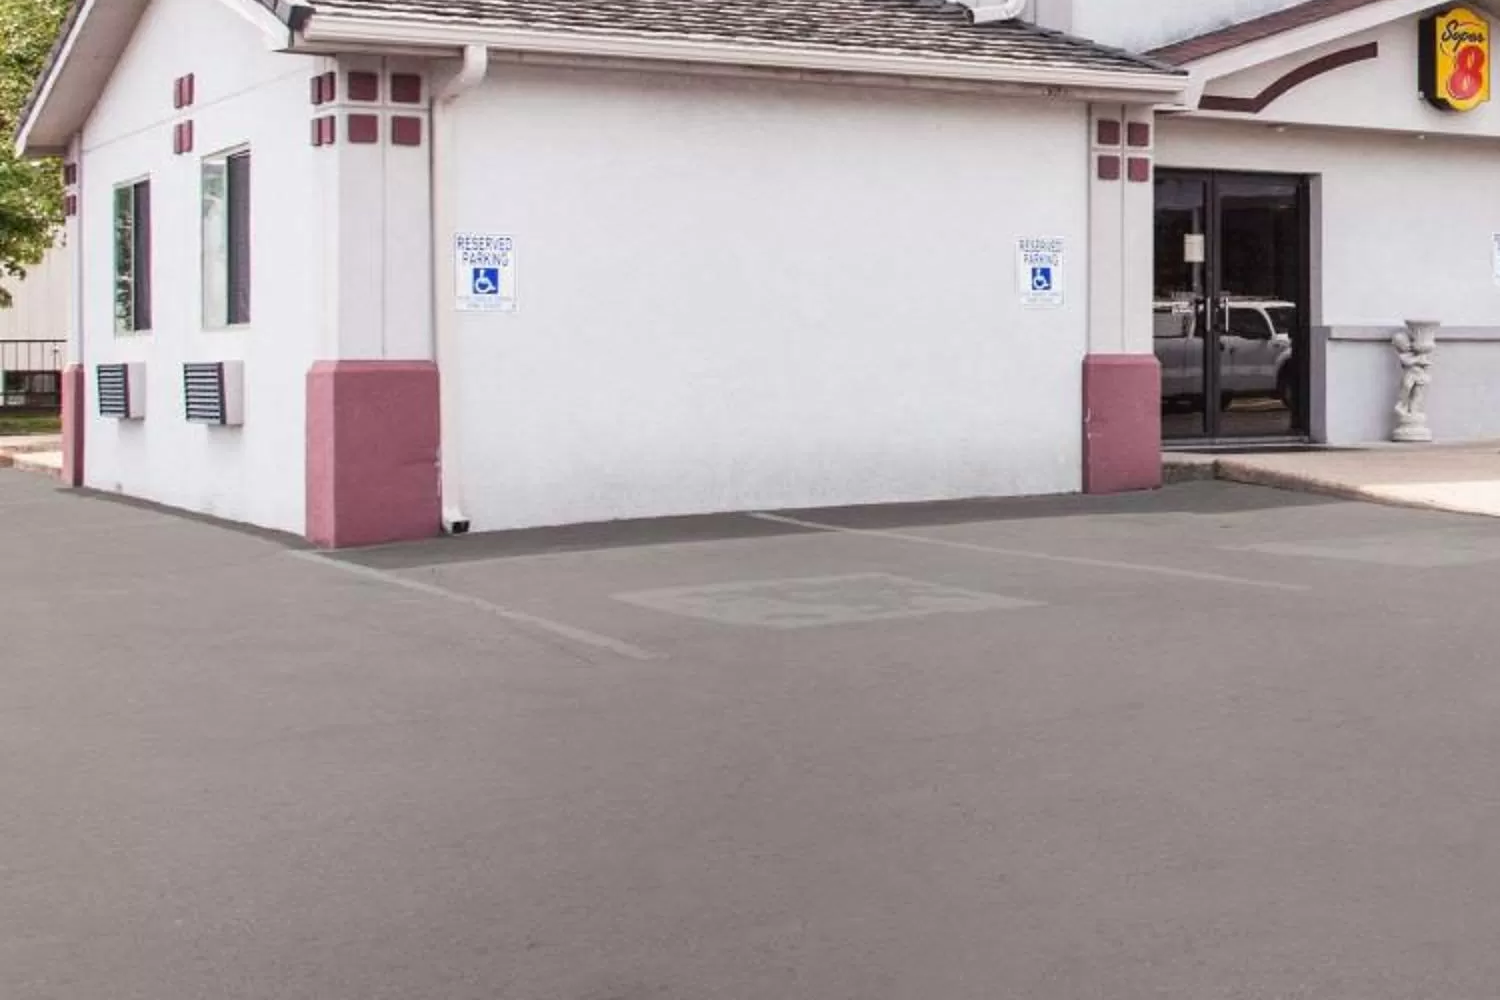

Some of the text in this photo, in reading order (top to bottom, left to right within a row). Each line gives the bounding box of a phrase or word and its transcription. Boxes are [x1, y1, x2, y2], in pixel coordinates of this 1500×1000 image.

[1441, 19, 1485, 52] Super
[1448, 44, 1485, 100] 8
[457, 236, 513, 250] RESERVED
[462, 251, 509, 266] PARKING
